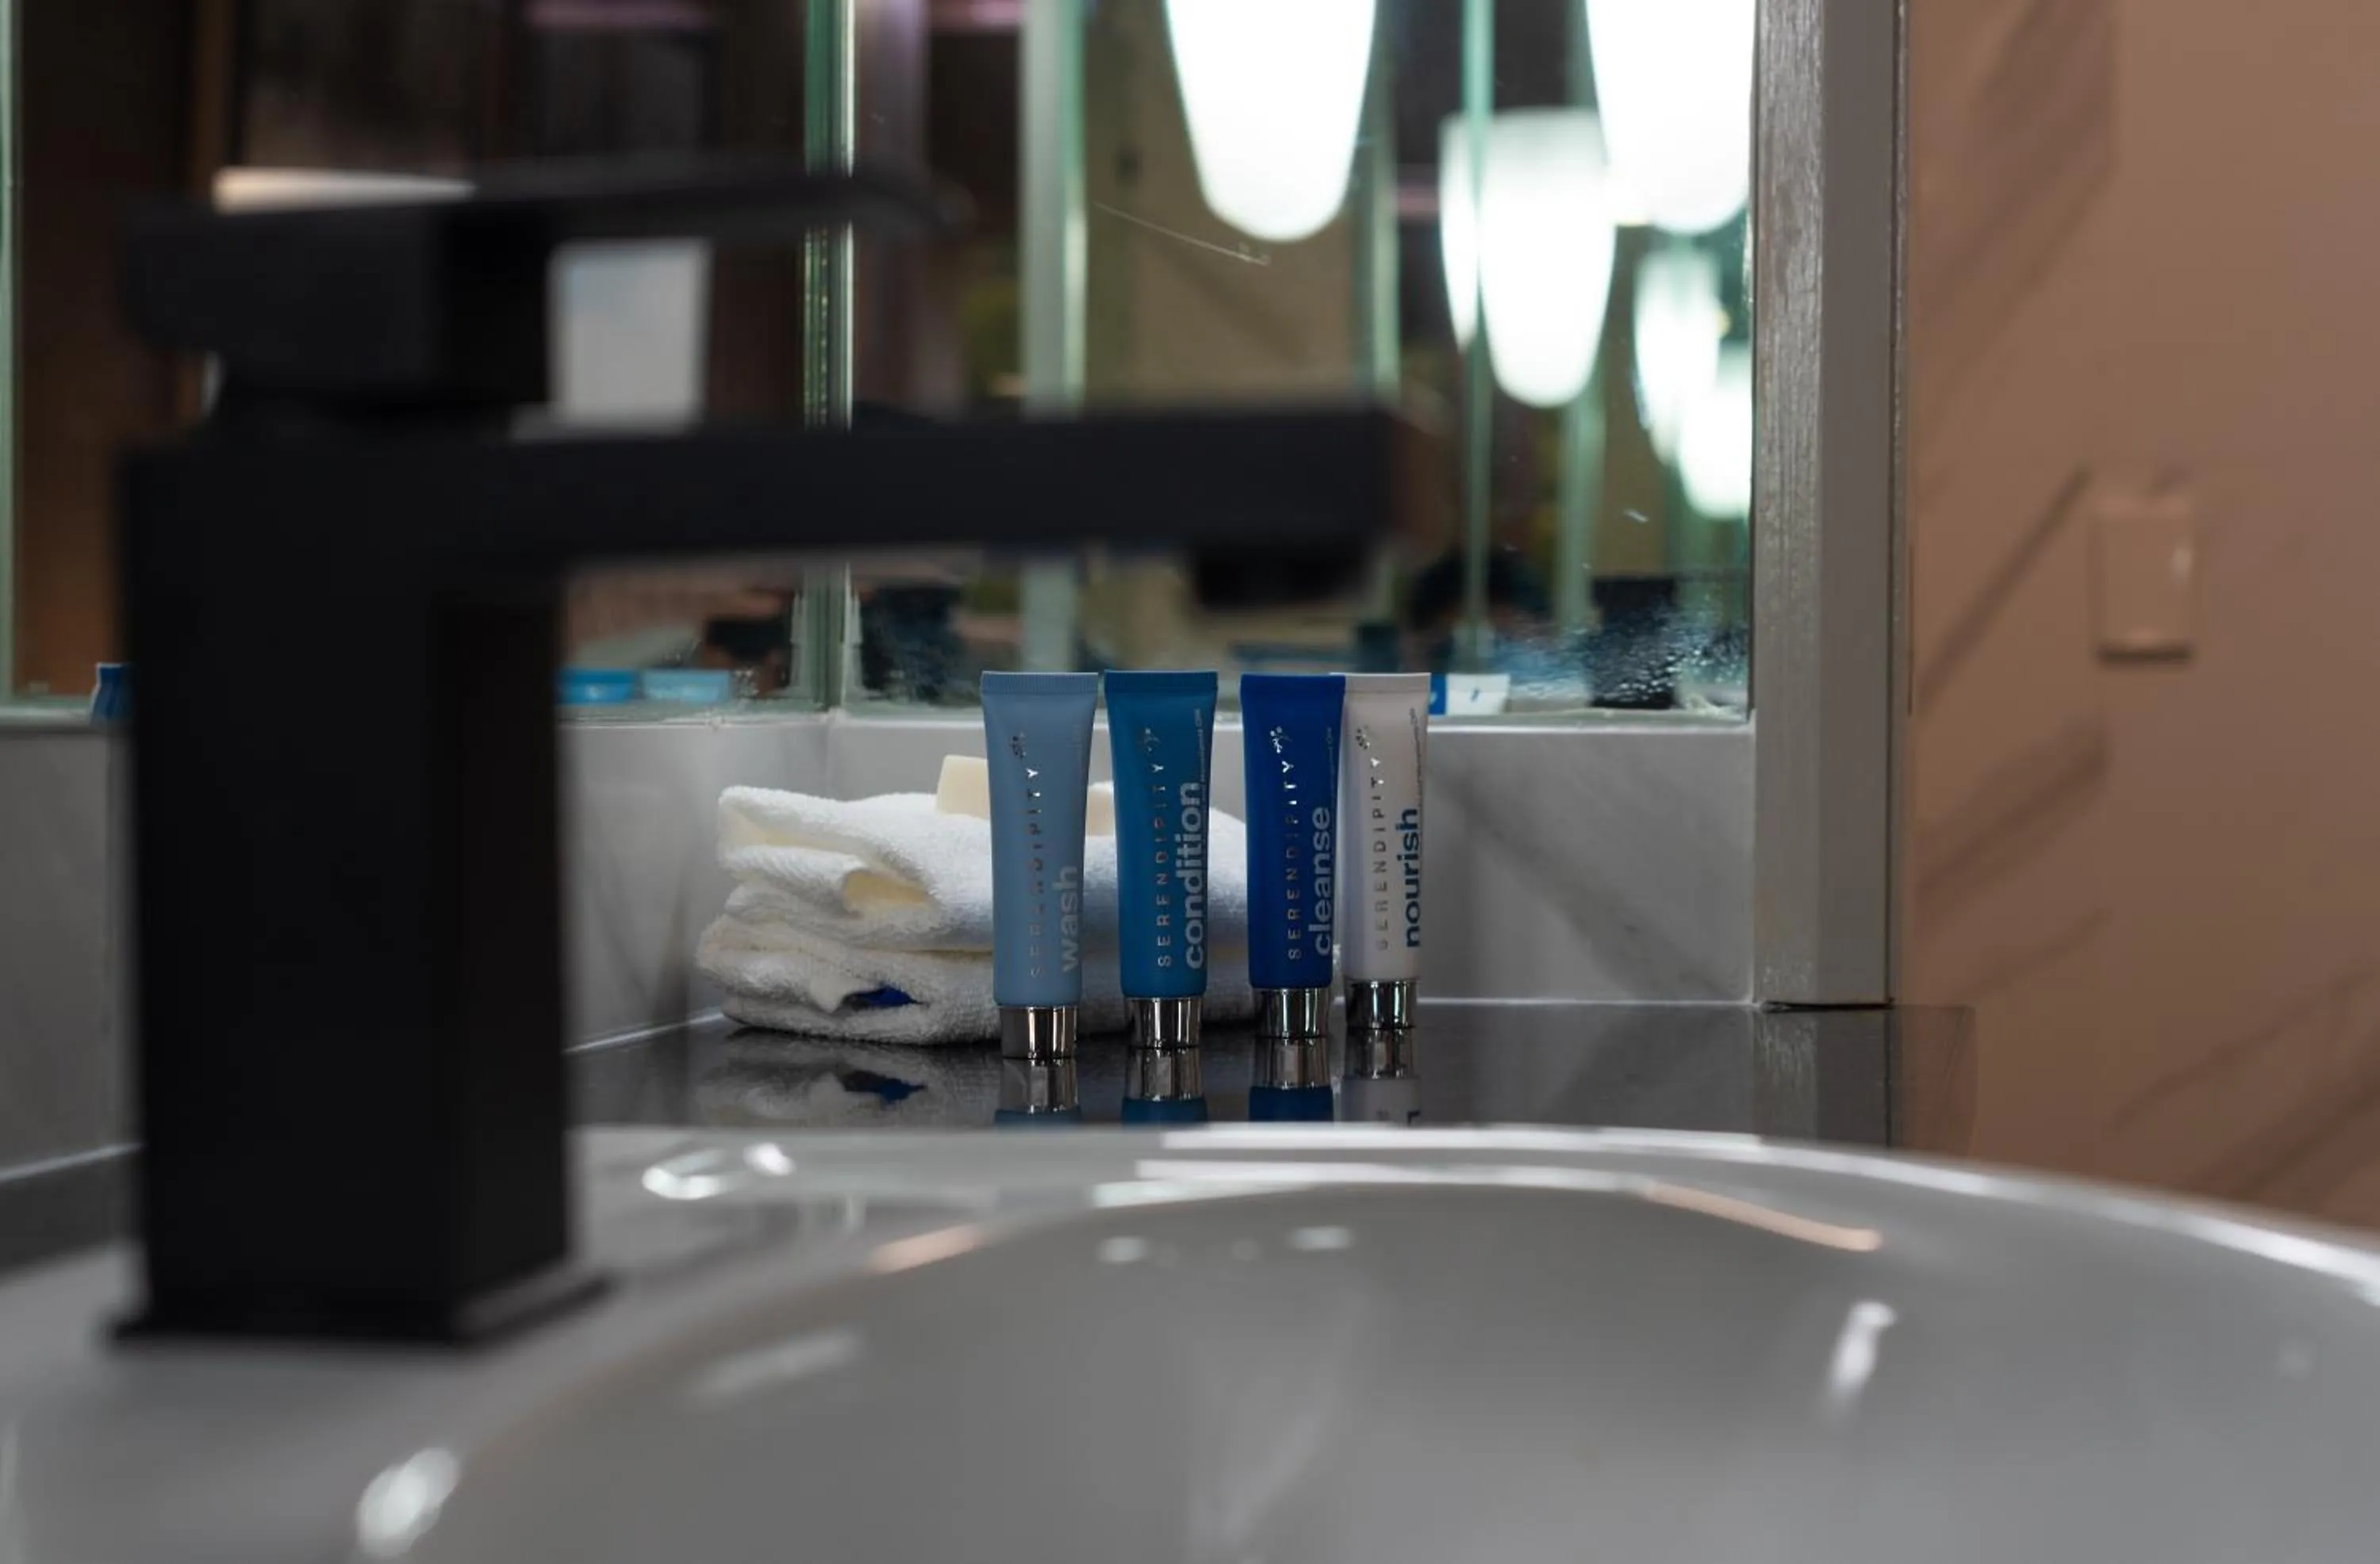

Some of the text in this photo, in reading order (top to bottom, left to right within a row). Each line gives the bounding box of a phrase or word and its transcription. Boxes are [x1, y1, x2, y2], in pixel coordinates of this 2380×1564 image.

[1051, 867, 1080, 972] wash
[1152, 763, 1172, 968] SERENDIPITY
[1176, 782, 1205, 969] condition
[1281, 760, 1301, 960] SERENDIPITY
[1308, 807, 1333, 956] cleanse
[1370, 757, 1388, 951] SERENDIPITY
[1395, 807, 1421, 949] nourish
